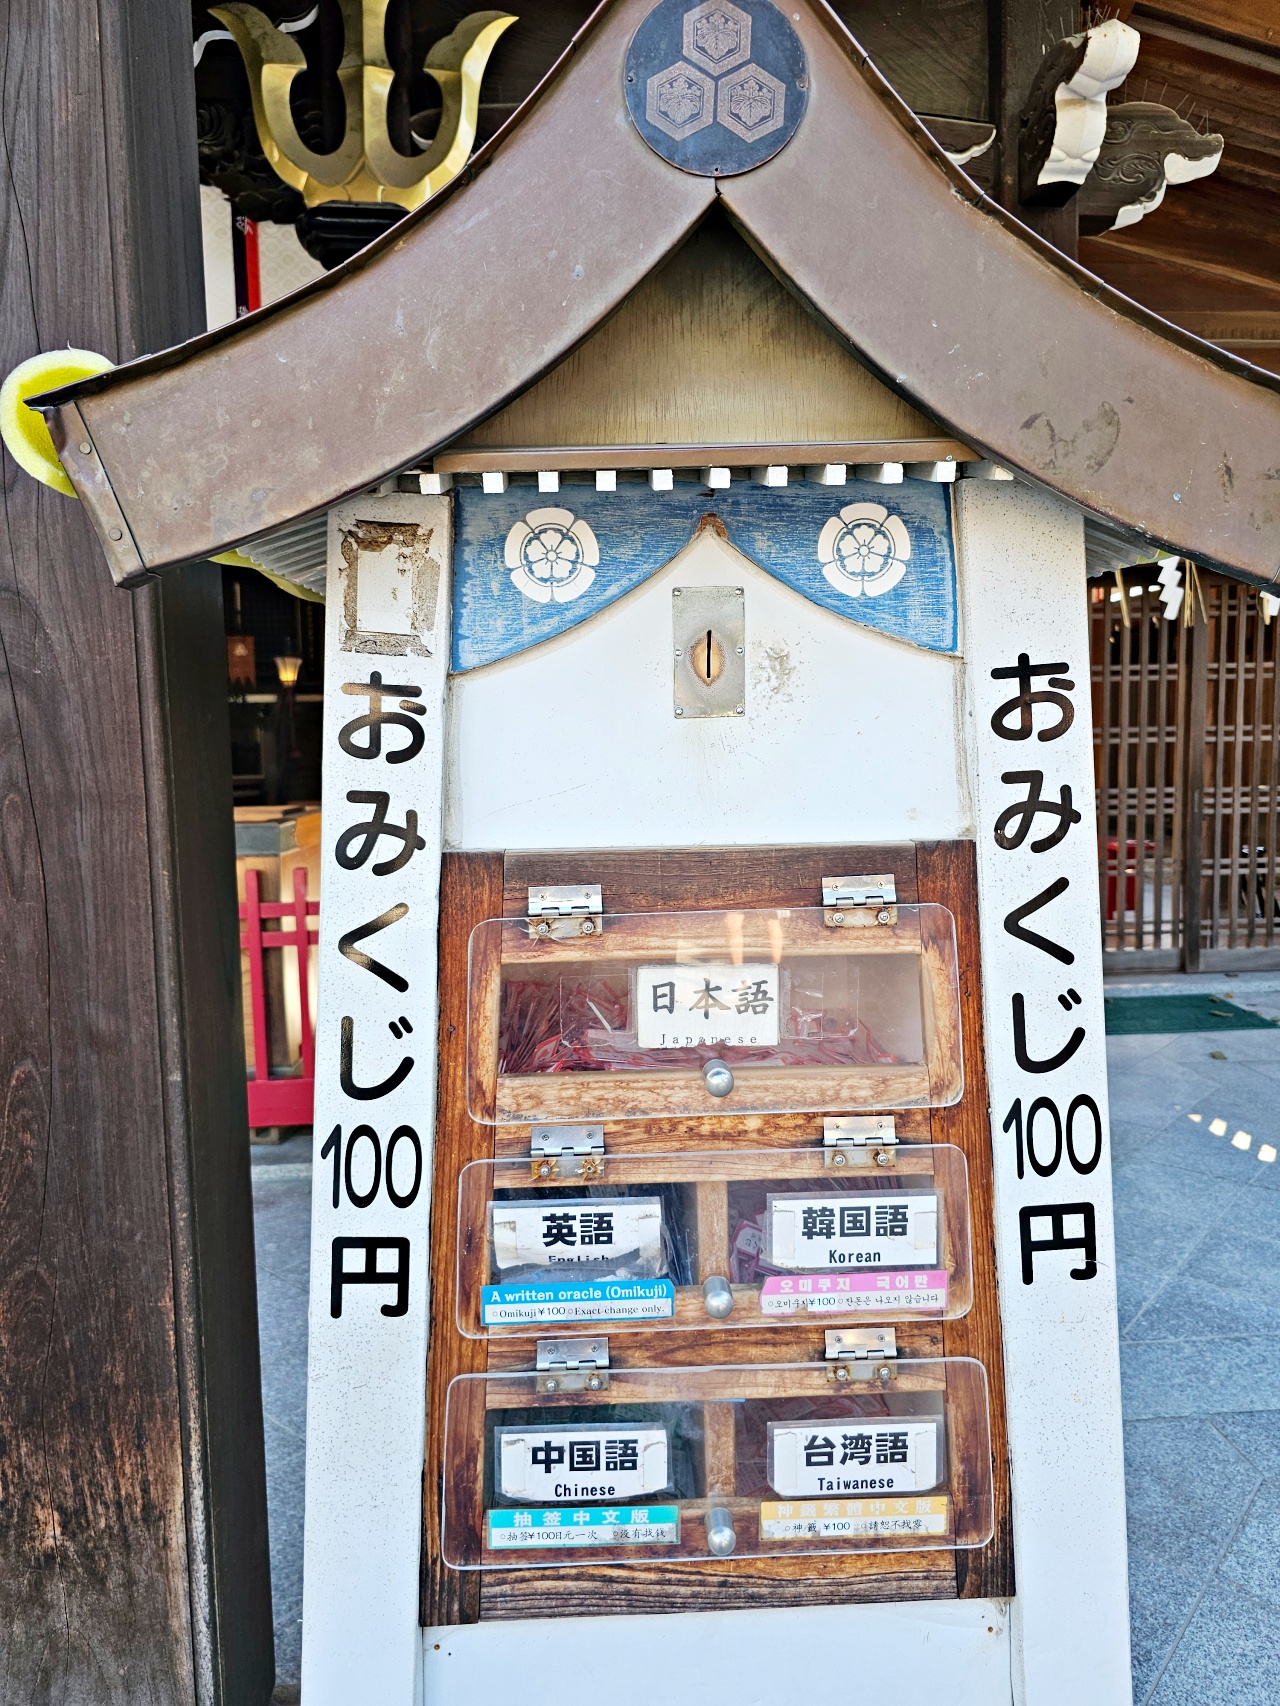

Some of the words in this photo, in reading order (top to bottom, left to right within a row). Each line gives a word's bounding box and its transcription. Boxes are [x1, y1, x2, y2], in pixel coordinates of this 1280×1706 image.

[990, 653, 1102, 1286] おみくじ100円
[321, 671, 428, 1320] おみくじ100円
[652, 978, 774, 1019] 日本語
[660, 1034, 758, 1047] Japanese
[542, 1212, 614, 1247] 英語
[801, 1204, 909, 1240] 韓国語
[829, 1249, 881, 1263] Korean
[490, 1291, 501, 1303] A
[505, 1290, 554, 1302] written
[558, 1288, 602, 1300] oracle
[605, 1284, 667, 1299] (Omikuji)
[780, 1277, 851, 1293] 오미쿠지
[575, 1307, 601, 1316] Exact
[604, 1306, 639, 1315] change
[641, 1304, 665, 1314] only.
[531, 1439, 639, 1473] 中国語
[804, 1431, 909, 1467] 台湾語
[554, 1484, 616, 1498] Chinese
[818, 1477, 894, 1491] Taiwanese
[513, 1509, 650, 1527] 抽签中文版
